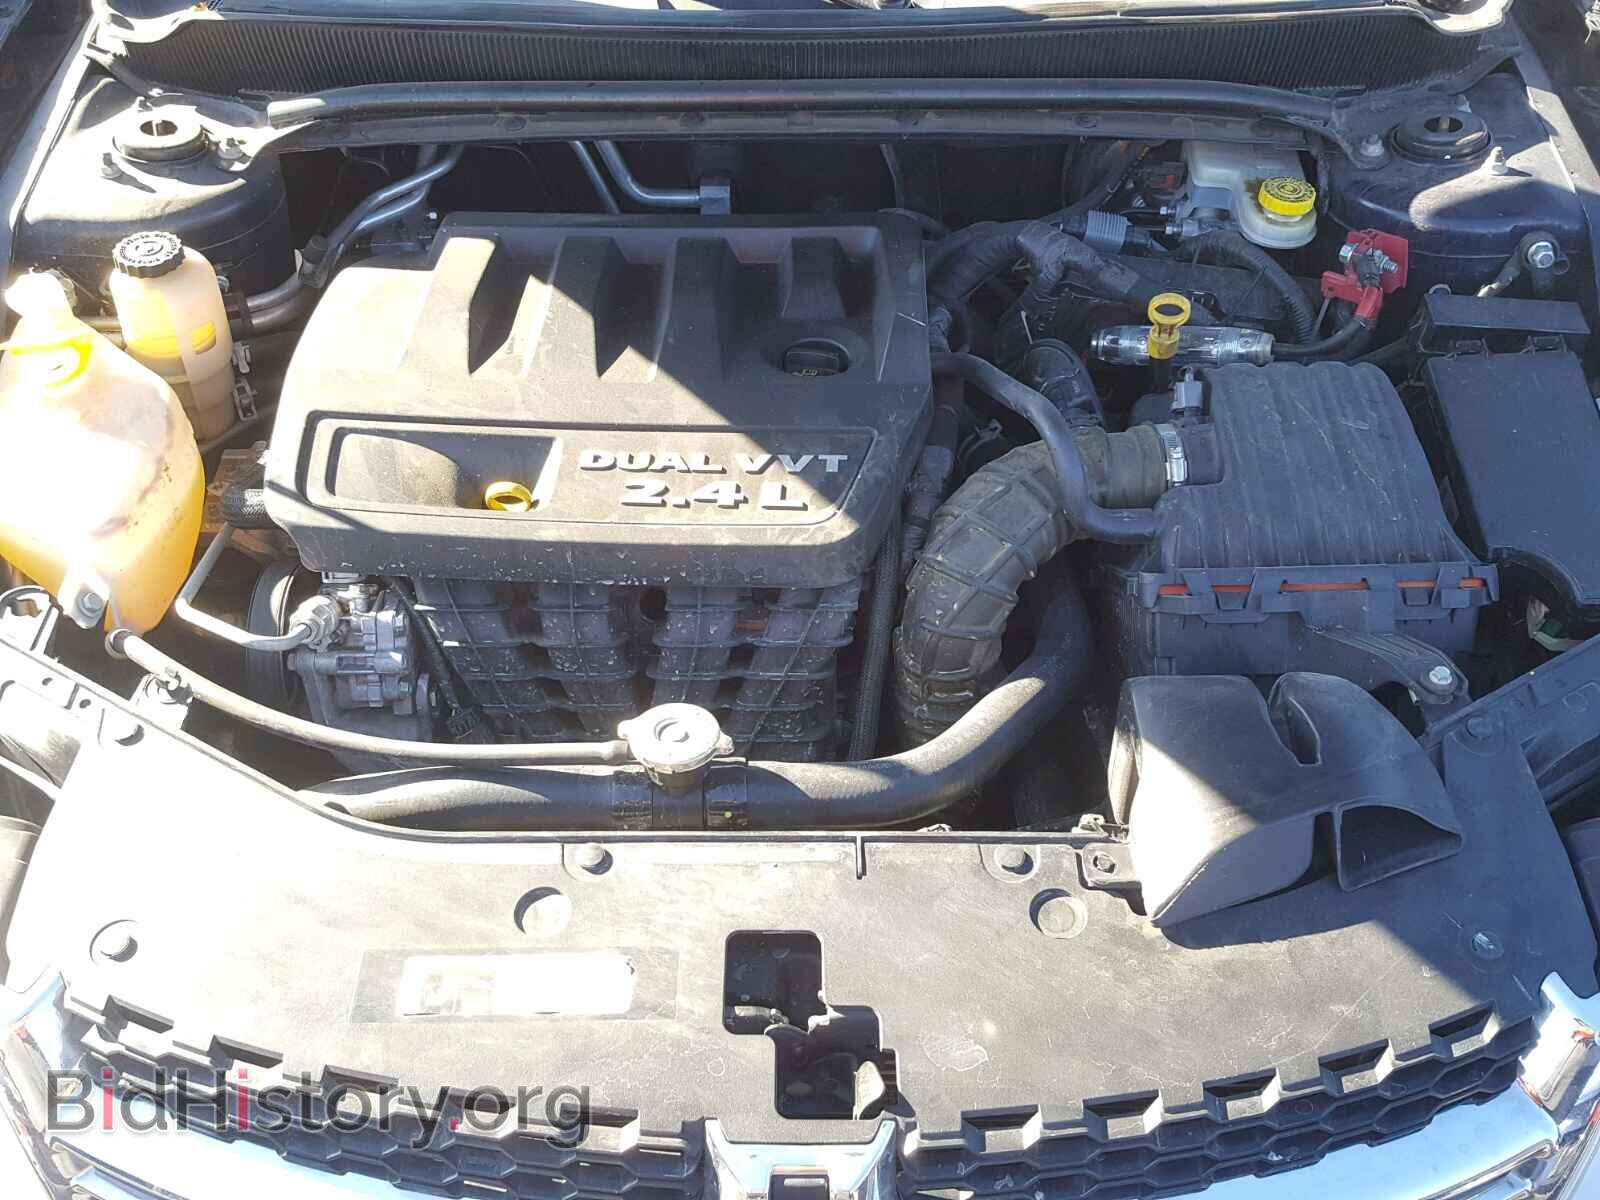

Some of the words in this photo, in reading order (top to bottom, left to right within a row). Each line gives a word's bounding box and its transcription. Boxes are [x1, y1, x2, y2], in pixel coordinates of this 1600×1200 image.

[579, 450, 727, 474] DUAL
[736, 453, 848, 475] VVT
[620, 479, 748, 509] 2.4
[760, 480, 809, 511] L
